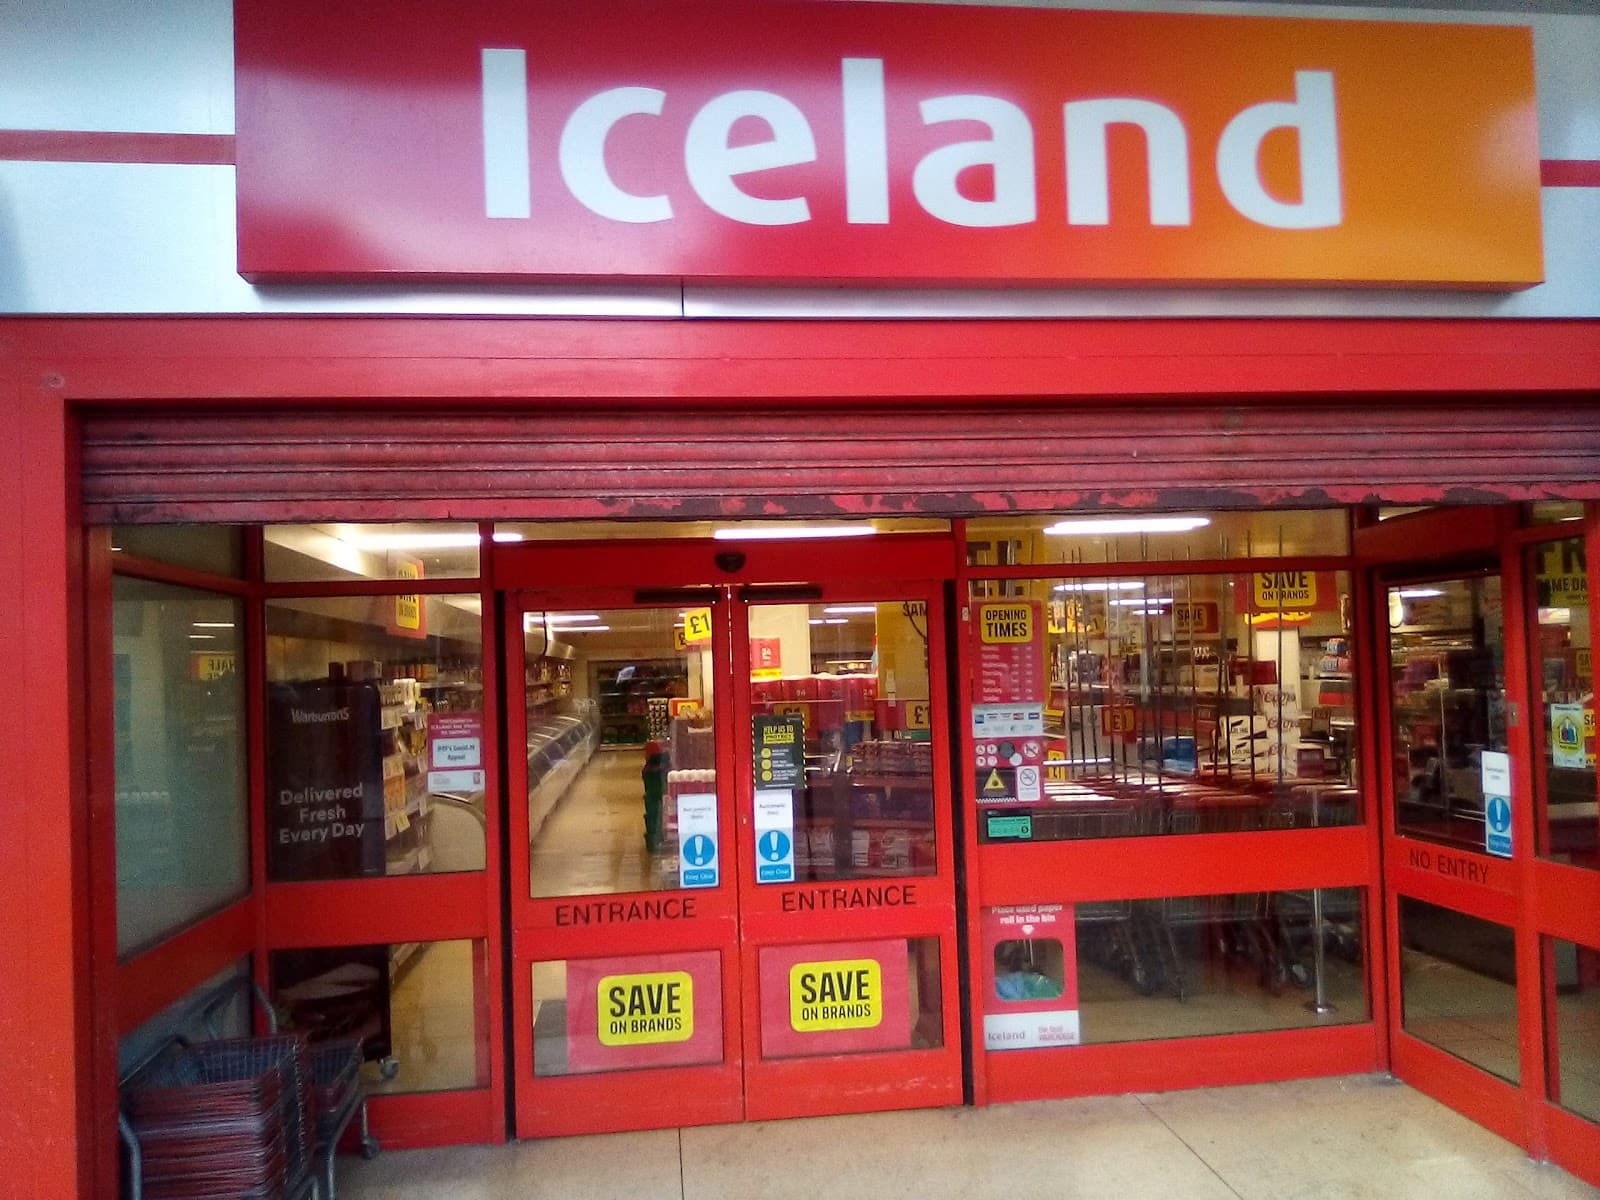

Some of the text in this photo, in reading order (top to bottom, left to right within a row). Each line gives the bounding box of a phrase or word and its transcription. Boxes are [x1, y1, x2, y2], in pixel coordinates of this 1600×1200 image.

[482, 48, 1343, 230] Iceland
[1261, 571, 1309, 590] SAVE
[690, 612, 710, 634] £1
[985, 609, 1027, 621] OPENING
[986, 622, 1028, 637] TIMES
[279, 782, 364, 806] Delivered
[299, 804, 347, 823] Fresh
[279, 823, 366, 844] Every Day
[1409, 847, 1488, 885] NO ENTRY
[781, 885, 917, 912] ENTRANCE
[555, 897, 697, 927] ENTRANCE
[1000, 914, 1056, 924] roll in the bin
[801, 969, 871, 1004] SAVE
[609, 982, 682, 1018] SAVE
[802, 1004, 872, 1021] ON BRANDS
[610, 1018, 682, 1035] ON BRANDS
